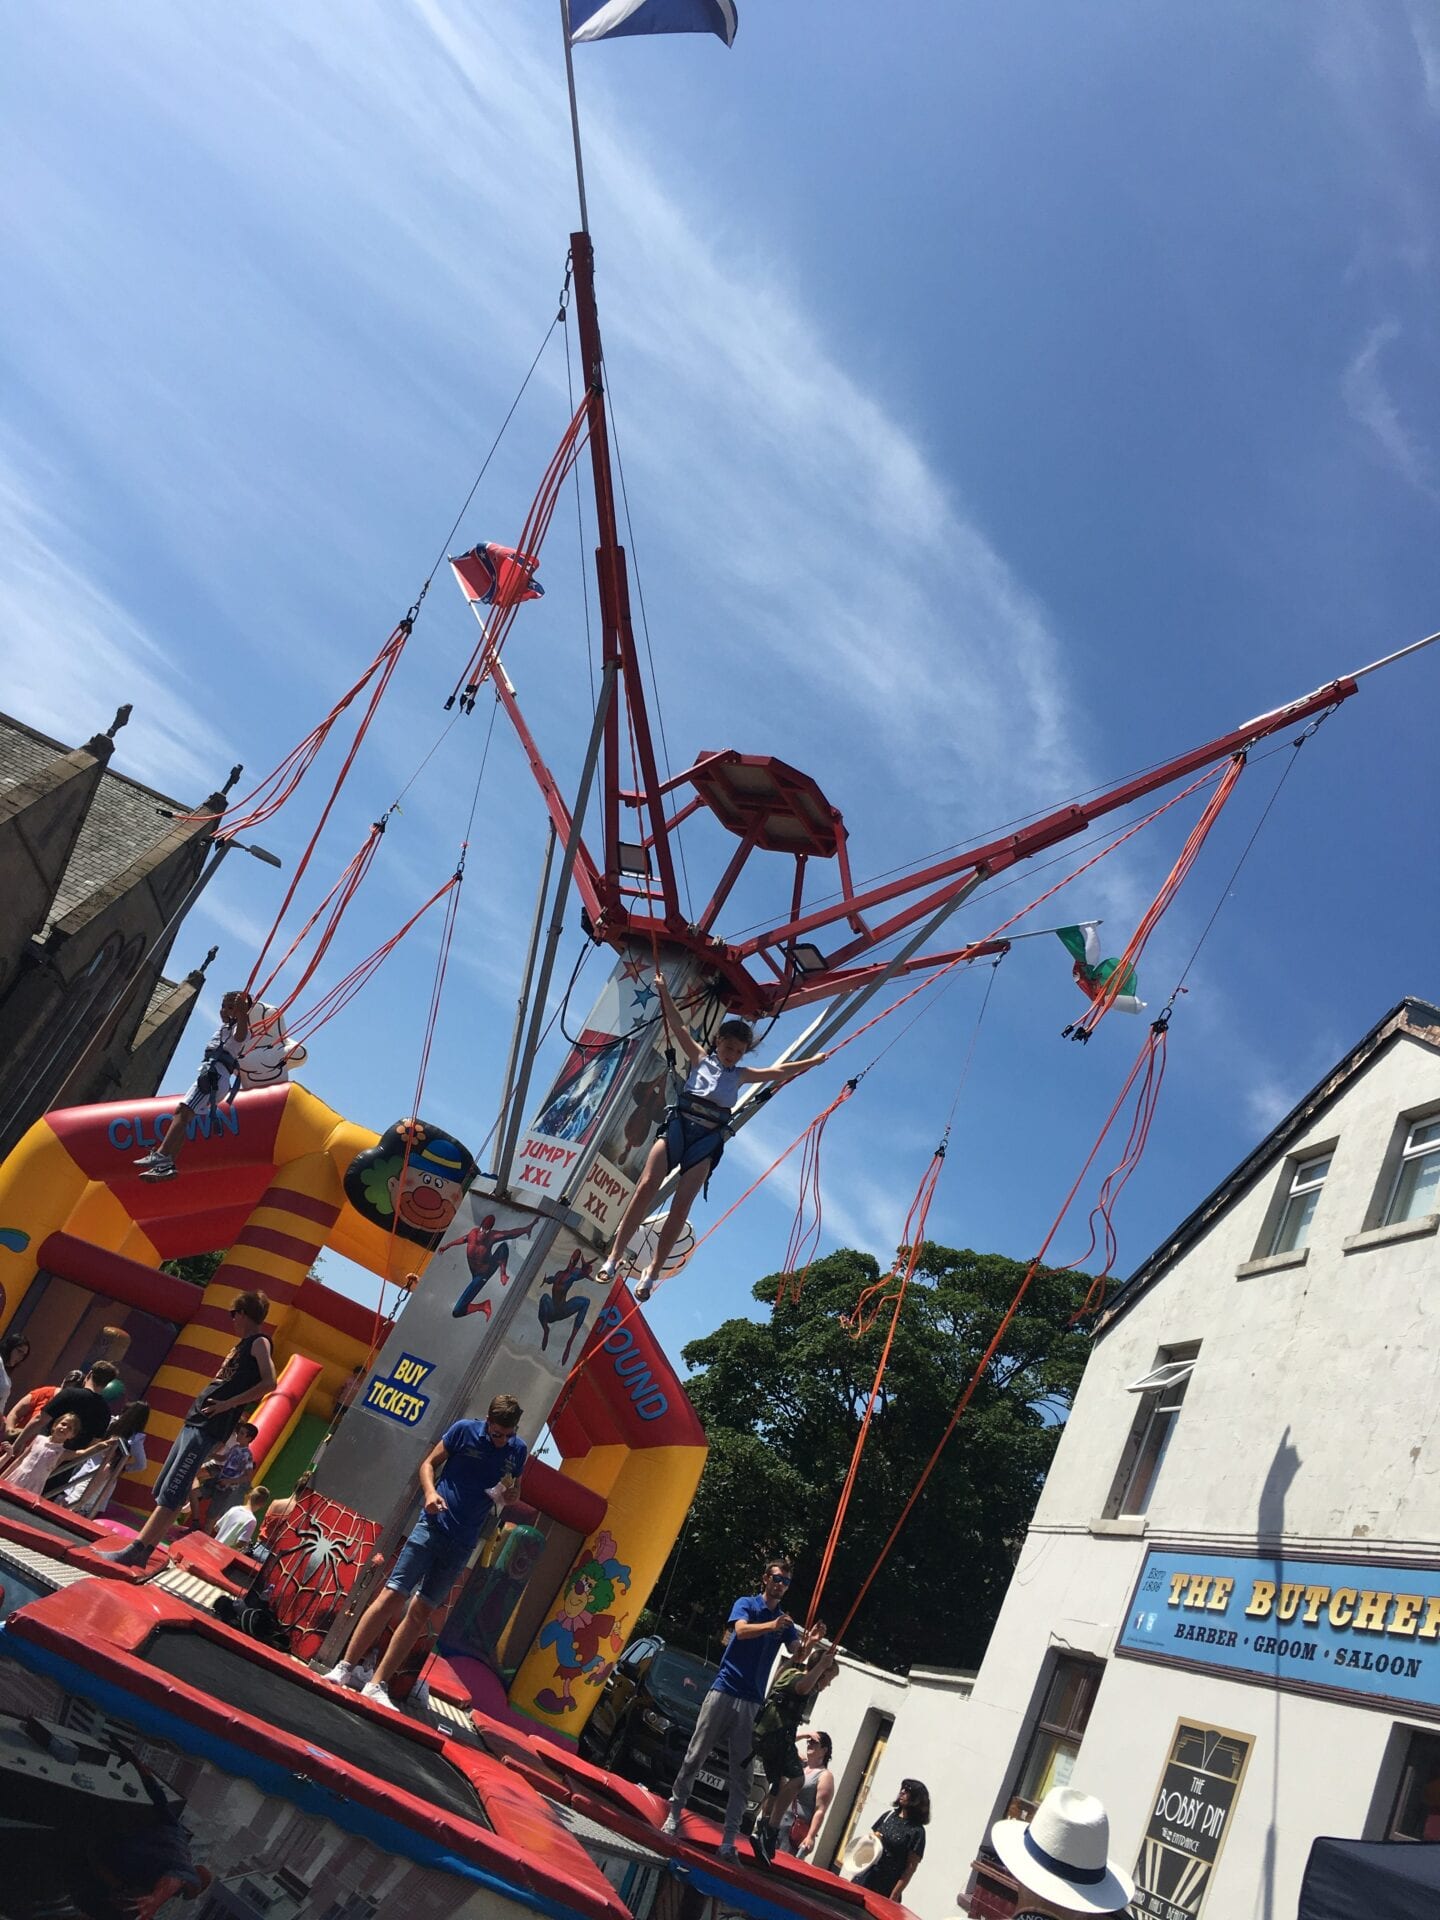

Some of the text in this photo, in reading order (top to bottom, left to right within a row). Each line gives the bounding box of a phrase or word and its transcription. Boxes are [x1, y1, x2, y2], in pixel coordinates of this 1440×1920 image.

[519, 1139, 577, 1169] JUMPY
[518, 1164, 553, 1188] XXL
[586, 1162, 630, 1207] JUMPY
[582, 1191, 609, 1224] XXL
[393, 1358, 429, 1387] BUY
[367, 1381, 425, 1422] TICKETS
[166, 1452, 198, 1496] CONVERSE
[1167, 1571, 1235, 1612] THE
[1174, 1623, 1423, 1678] BARBER GROOM SALOON
[1190, 1776, 1206, 1795] THE
[1155, 1788, 1226, 1839] BOBBY PIN
